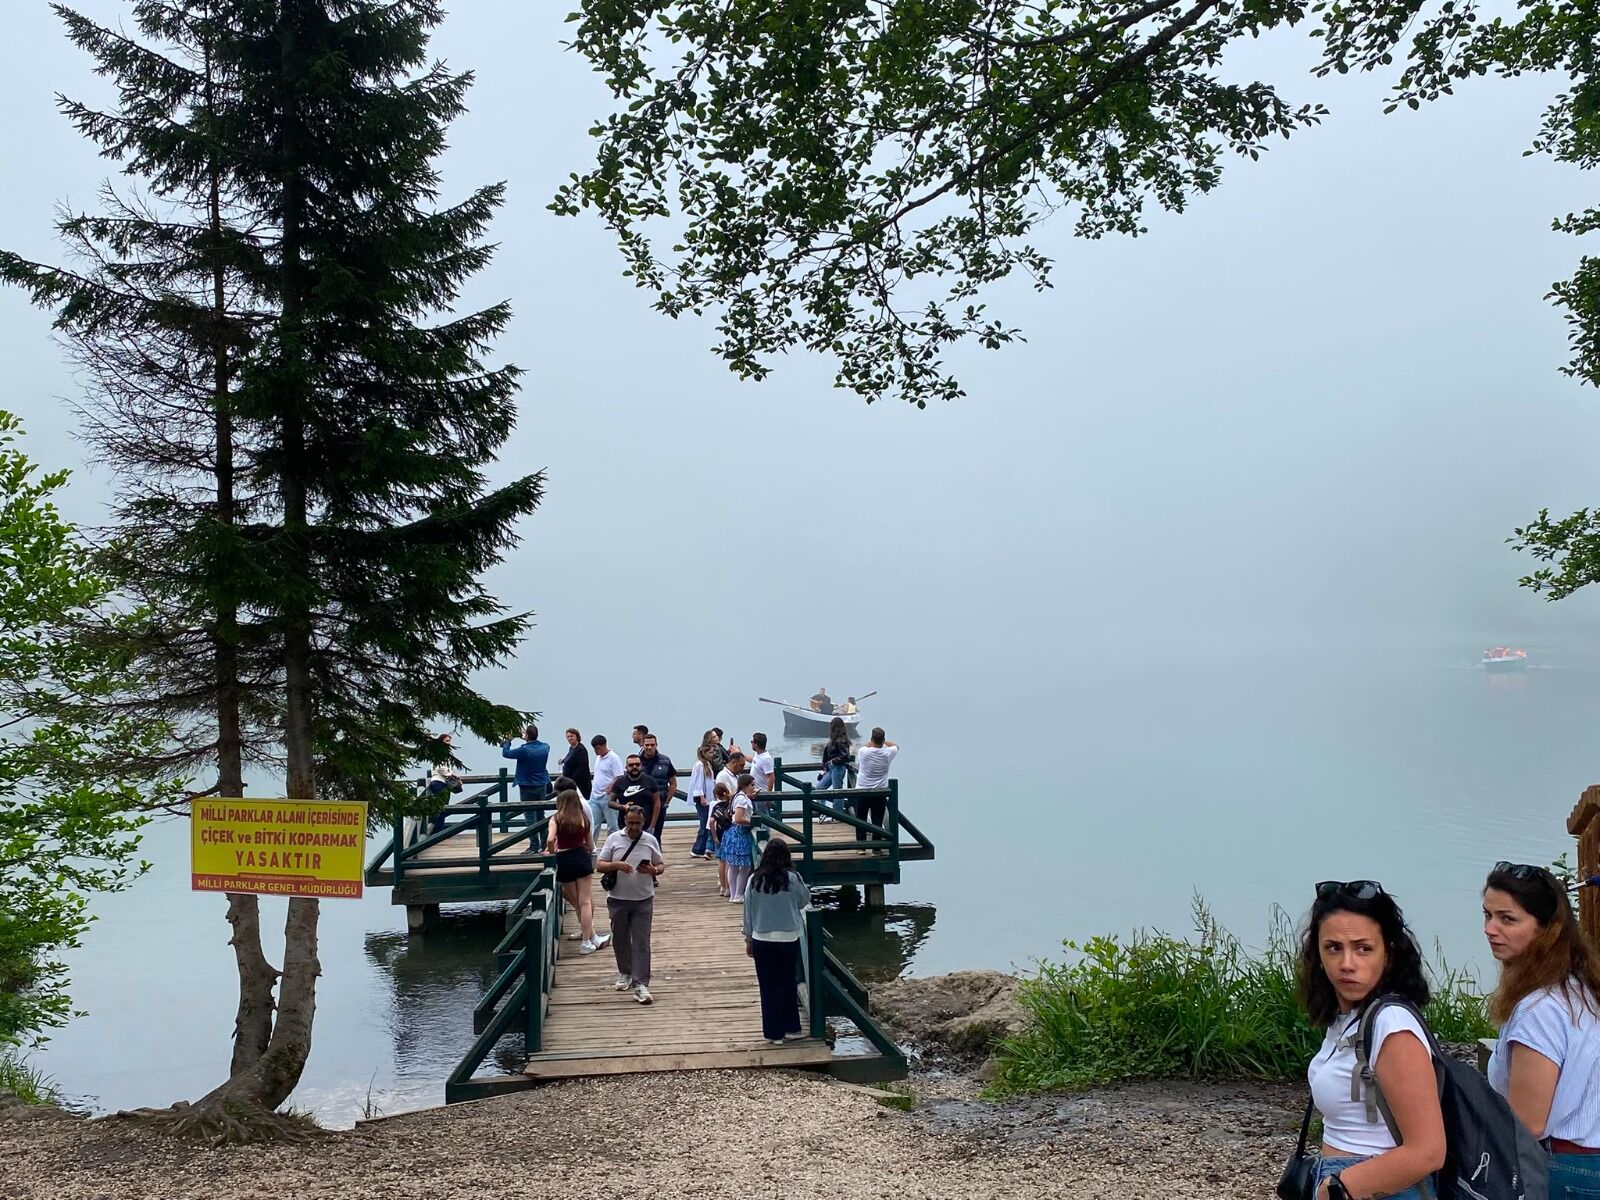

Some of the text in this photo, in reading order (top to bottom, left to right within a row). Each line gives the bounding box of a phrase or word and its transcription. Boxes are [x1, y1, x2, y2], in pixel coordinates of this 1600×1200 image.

[200, 804, 359, 827] MİLLİ PARKLAR ALANI İÇERİSİNDE
[201, 826, 357, 847] ÇİÇEK ve BİTKİ KOPARMAK
[235, 850, 322, 869] YASAKTIR
[198, 877, 358, 895] MİLLİ PARKLAR GENEL MÜDÜRLÜĞÜ
